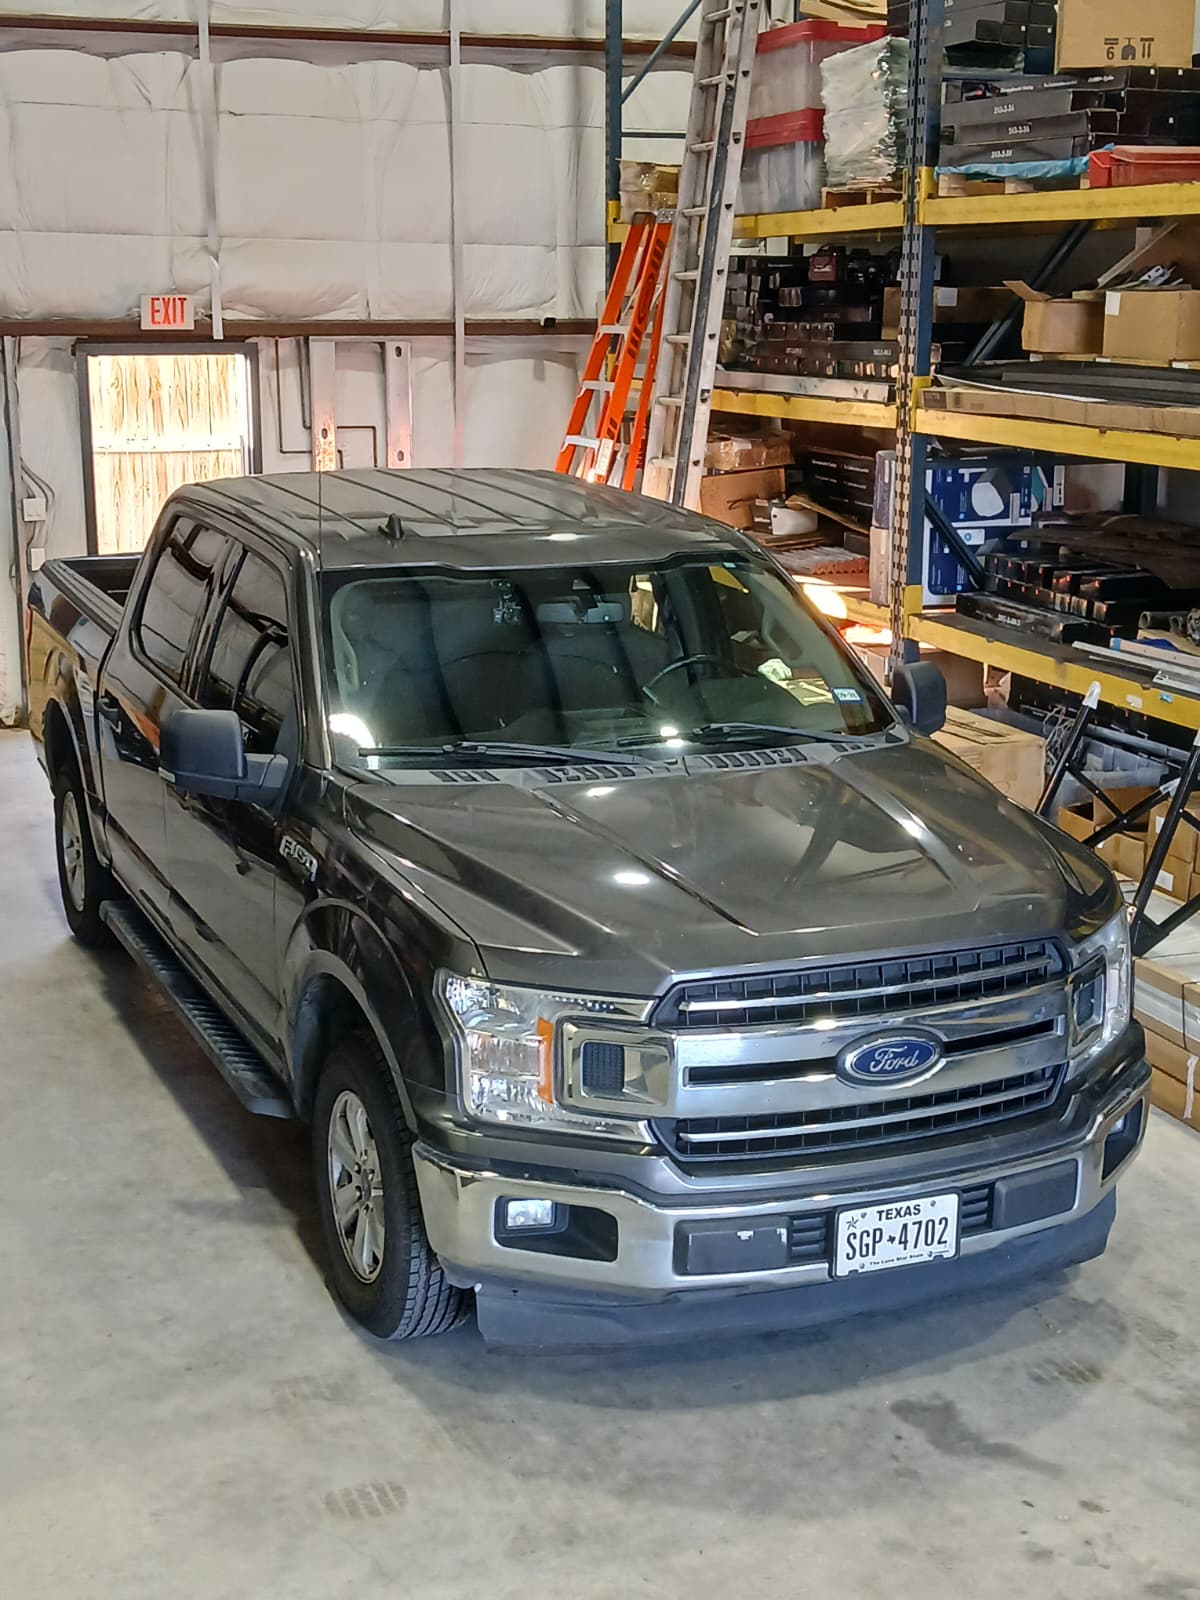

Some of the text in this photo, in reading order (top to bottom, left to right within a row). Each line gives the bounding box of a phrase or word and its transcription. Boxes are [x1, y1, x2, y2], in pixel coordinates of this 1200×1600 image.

[151, 297, 187, 325] EXIT
[869, 1045, 919, 1072] Ford
[876, 1204, 921, 1221] TEXAS
[898, 1216, 949, 1250] 4702
